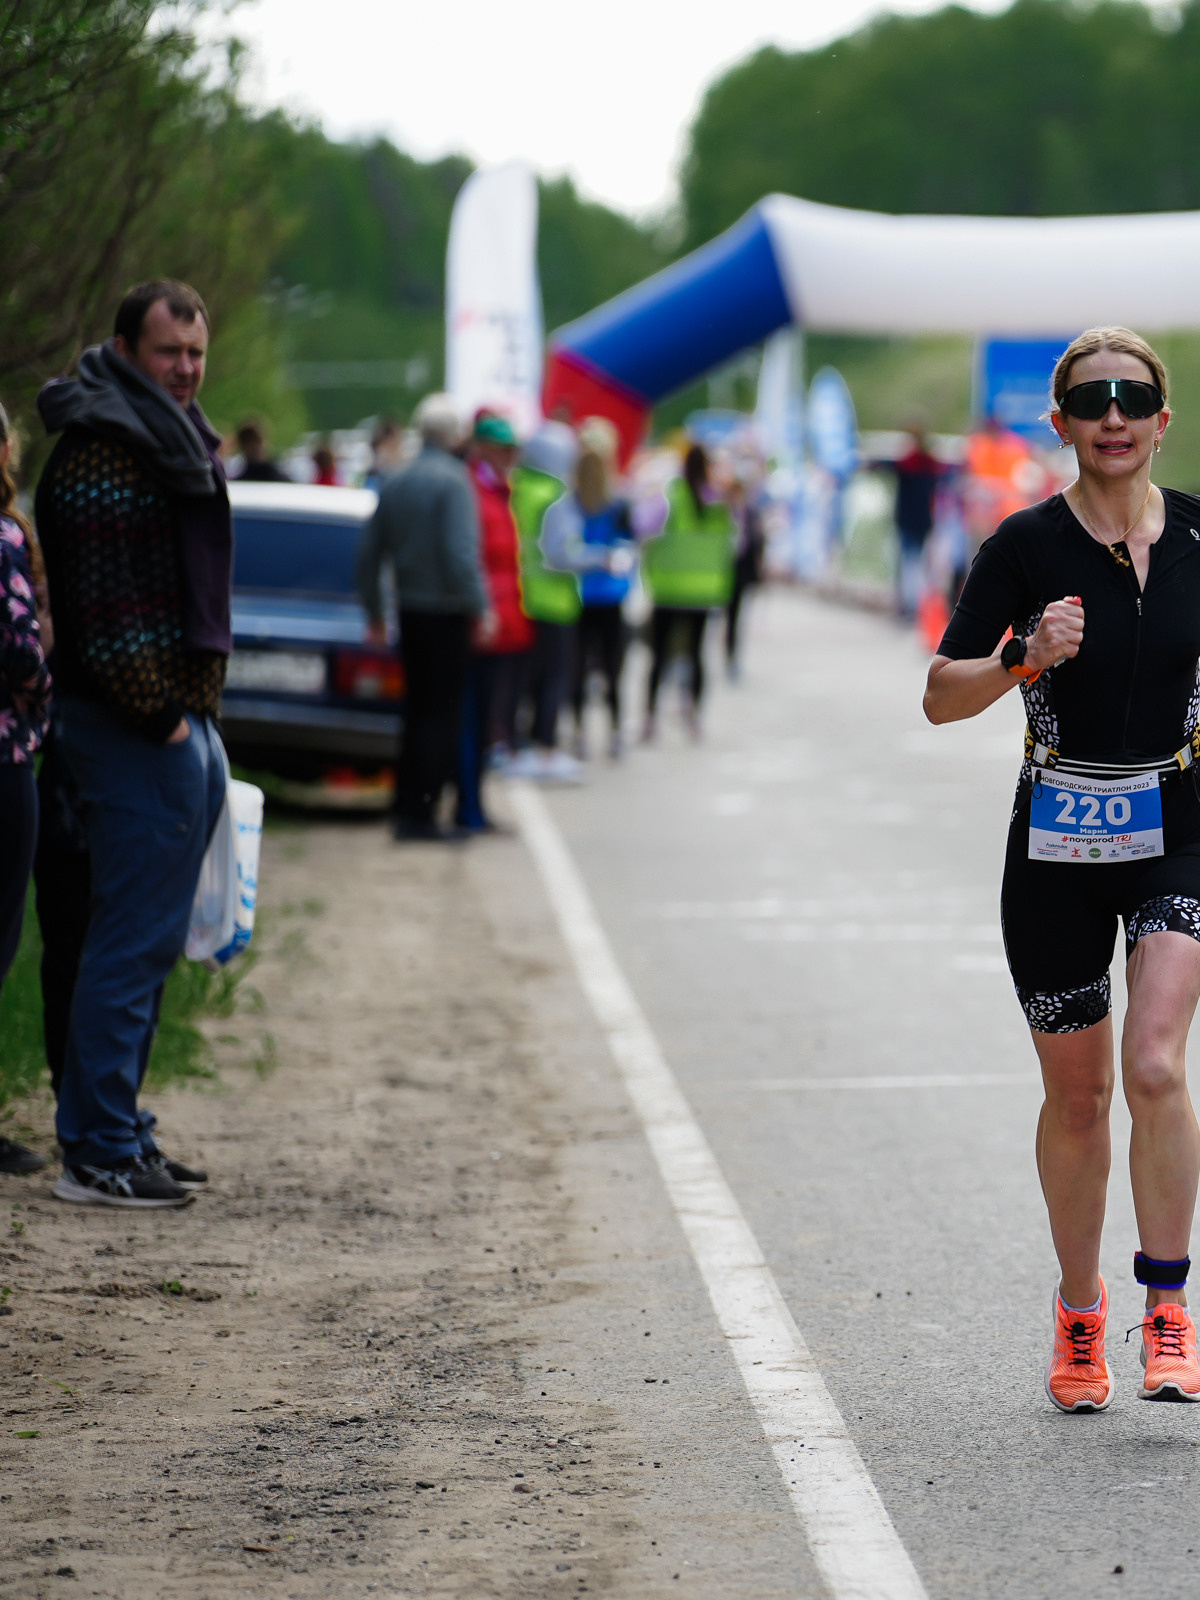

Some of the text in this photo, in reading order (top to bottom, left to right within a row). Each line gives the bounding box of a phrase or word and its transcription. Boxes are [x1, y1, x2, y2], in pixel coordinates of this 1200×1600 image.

[1094, 785, 1131, 794] ТРИАТЛОН
[1133, 782, 1149, 790] 2023
[1055, 791, 1132, 826] 220
[1079, 827, 1108, 835] Мария
